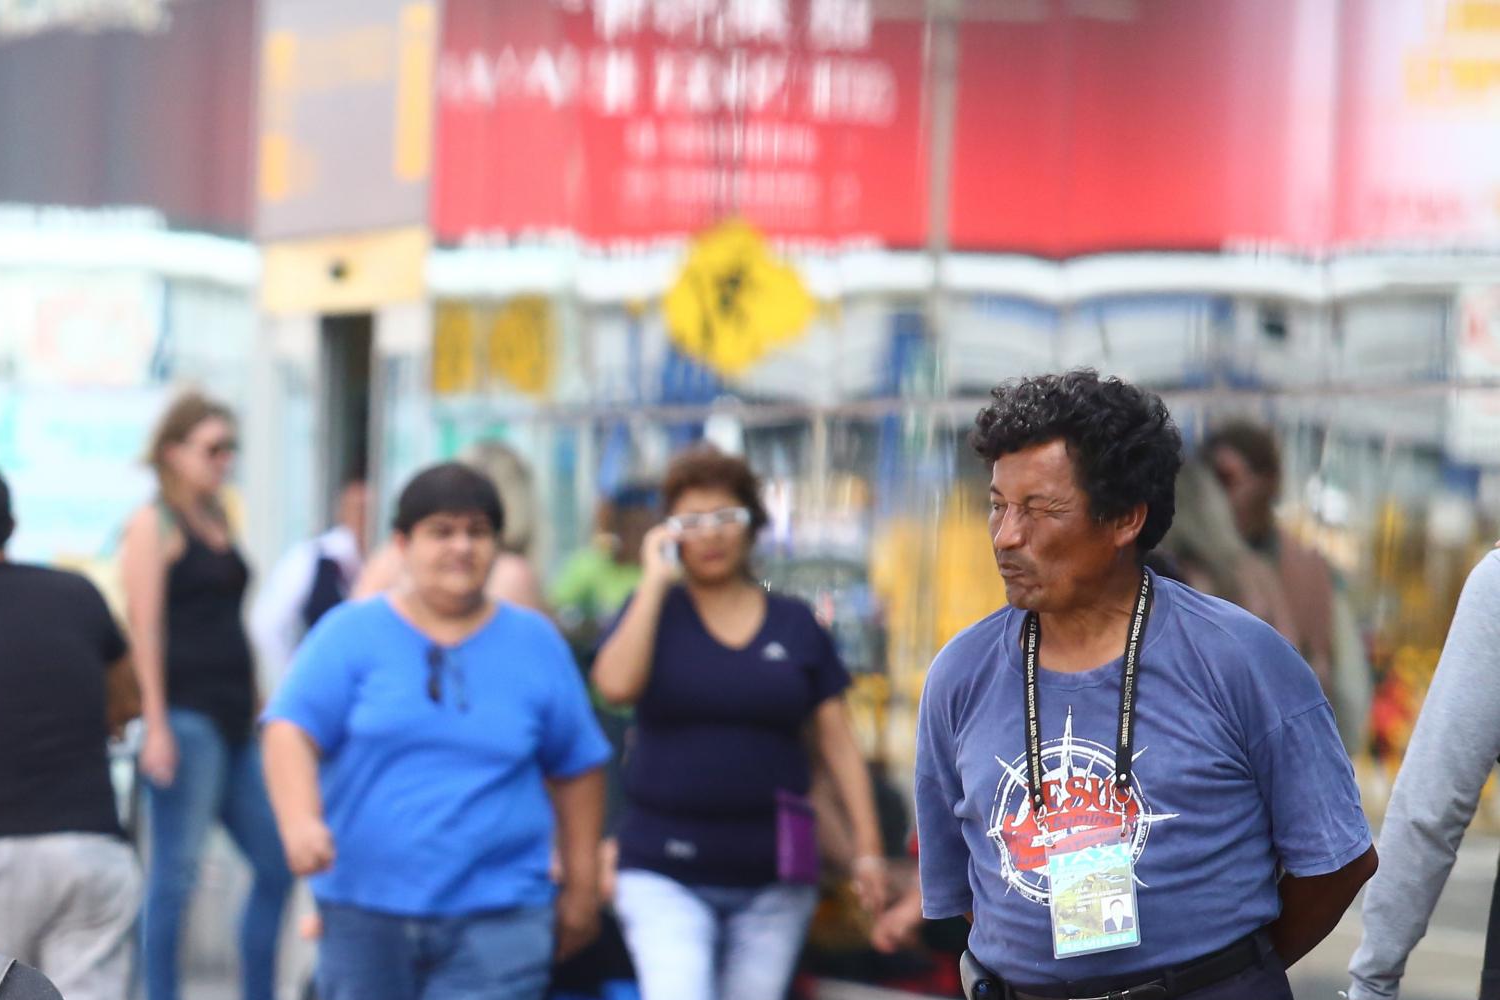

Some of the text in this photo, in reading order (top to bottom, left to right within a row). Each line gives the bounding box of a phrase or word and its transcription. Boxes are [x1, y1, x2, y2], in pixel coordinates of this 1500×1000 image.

[1028, 633, 1036, 653] PERU
[1027, 653, 1035, 683] PICCHU
[1138, 824, 1148, 843] VIDA
